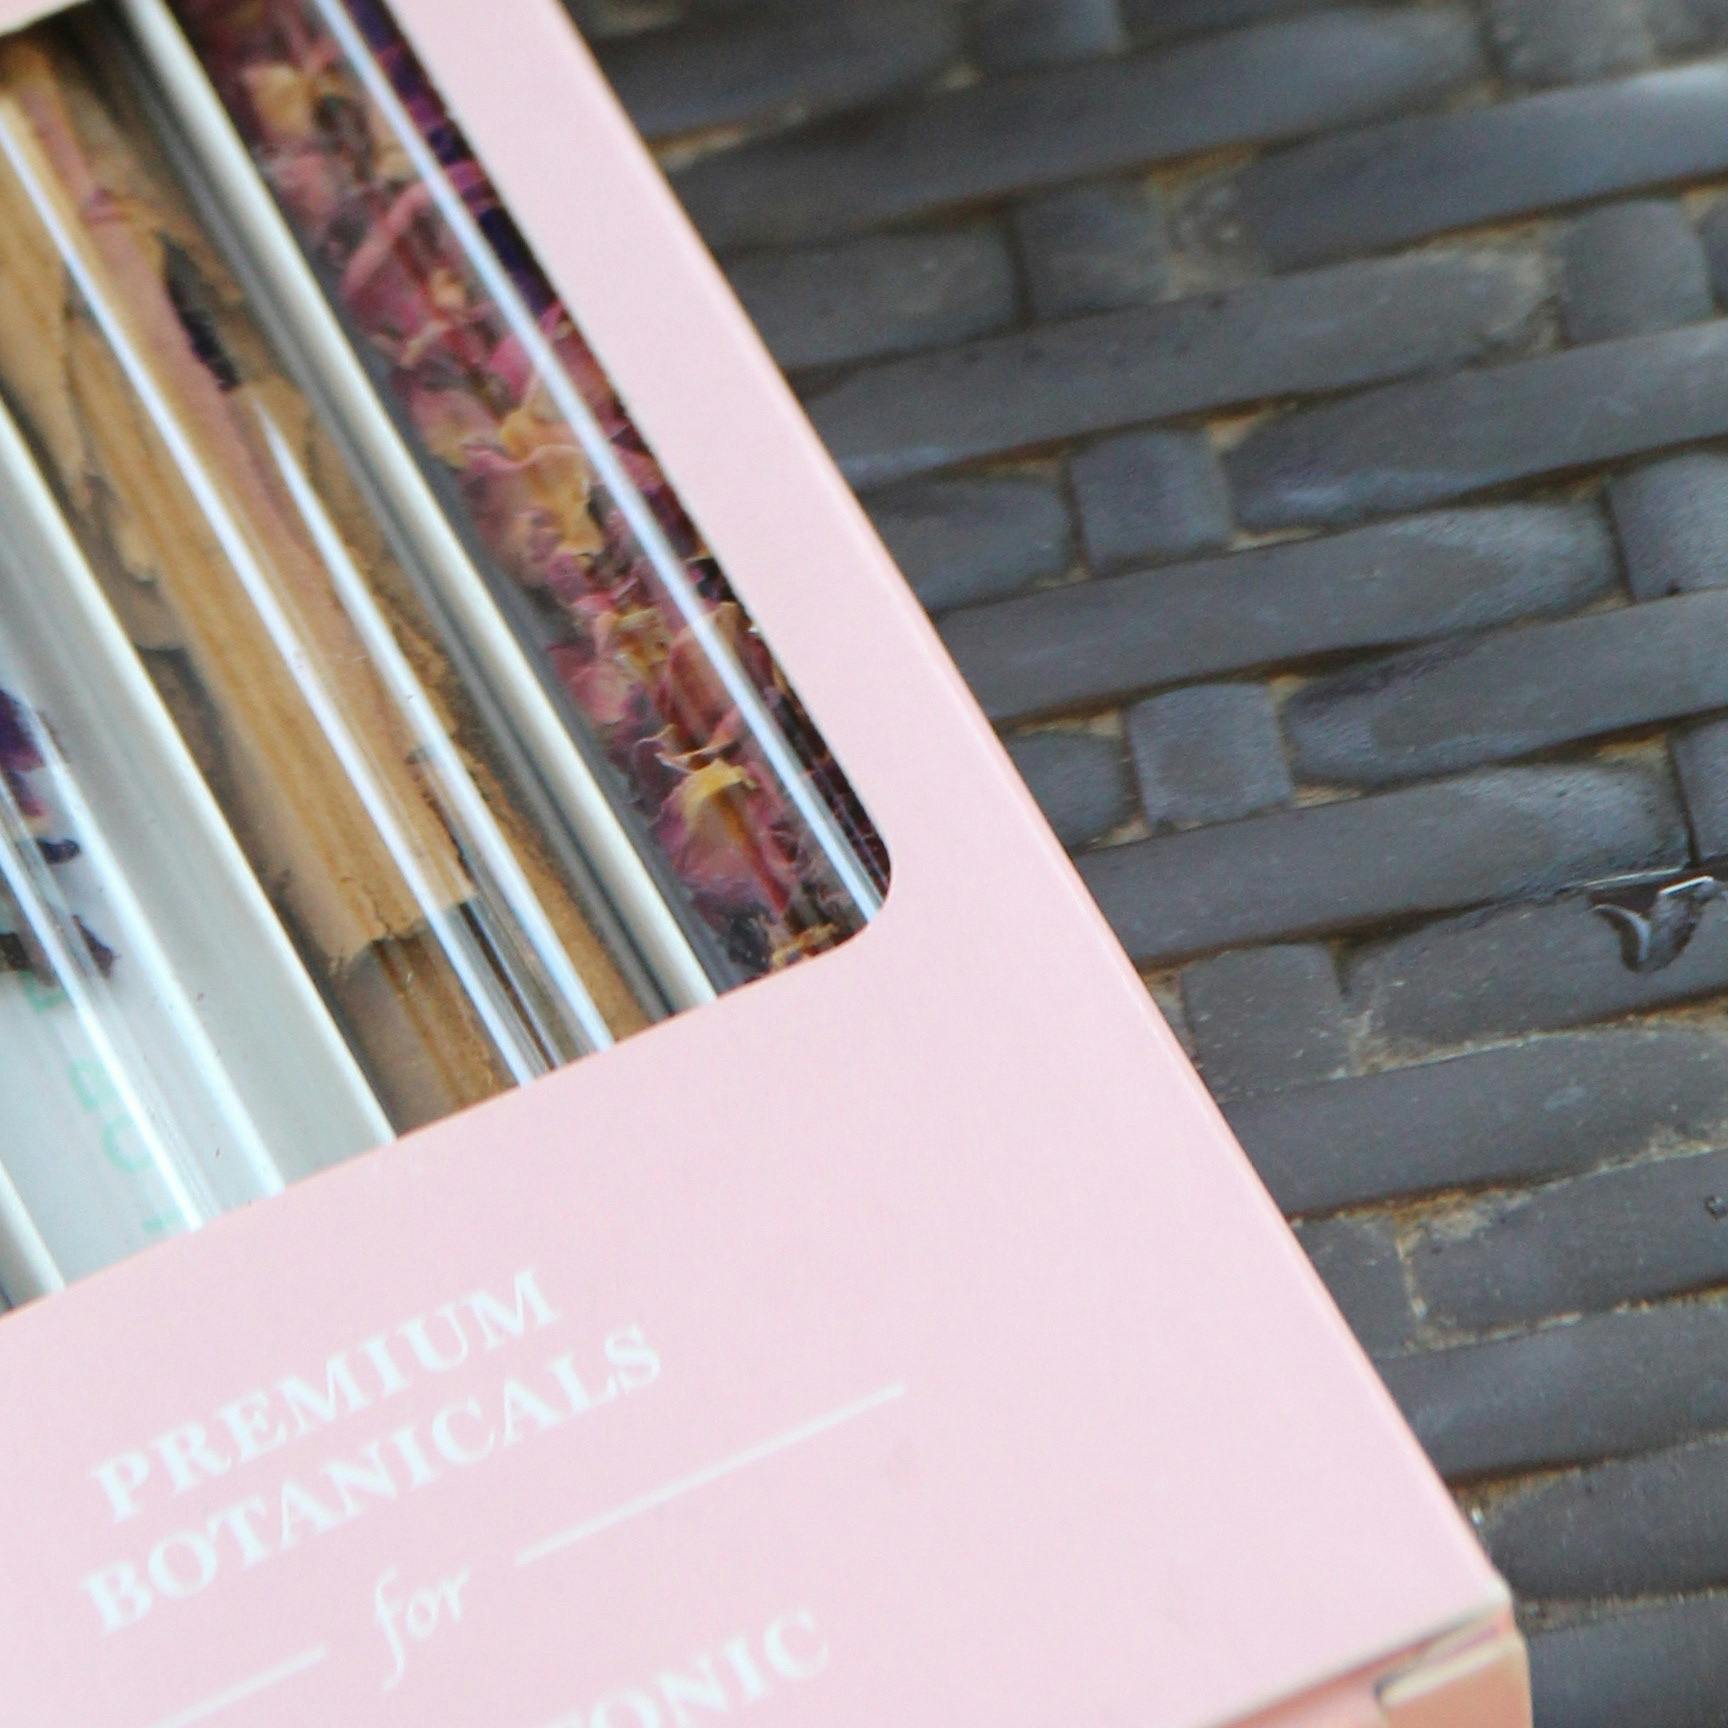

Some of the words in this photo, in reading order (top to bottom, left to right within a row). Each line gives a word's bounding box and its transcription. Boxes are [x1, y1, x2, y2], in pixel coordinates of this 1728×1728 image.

[80, 1321, 663, 1638] BOTANICALS
[89, 1266, 562, 1525] PREMIUM
[372, 1562, 470, 1691] for
[542, 1606, 829, 1728] ONIC
